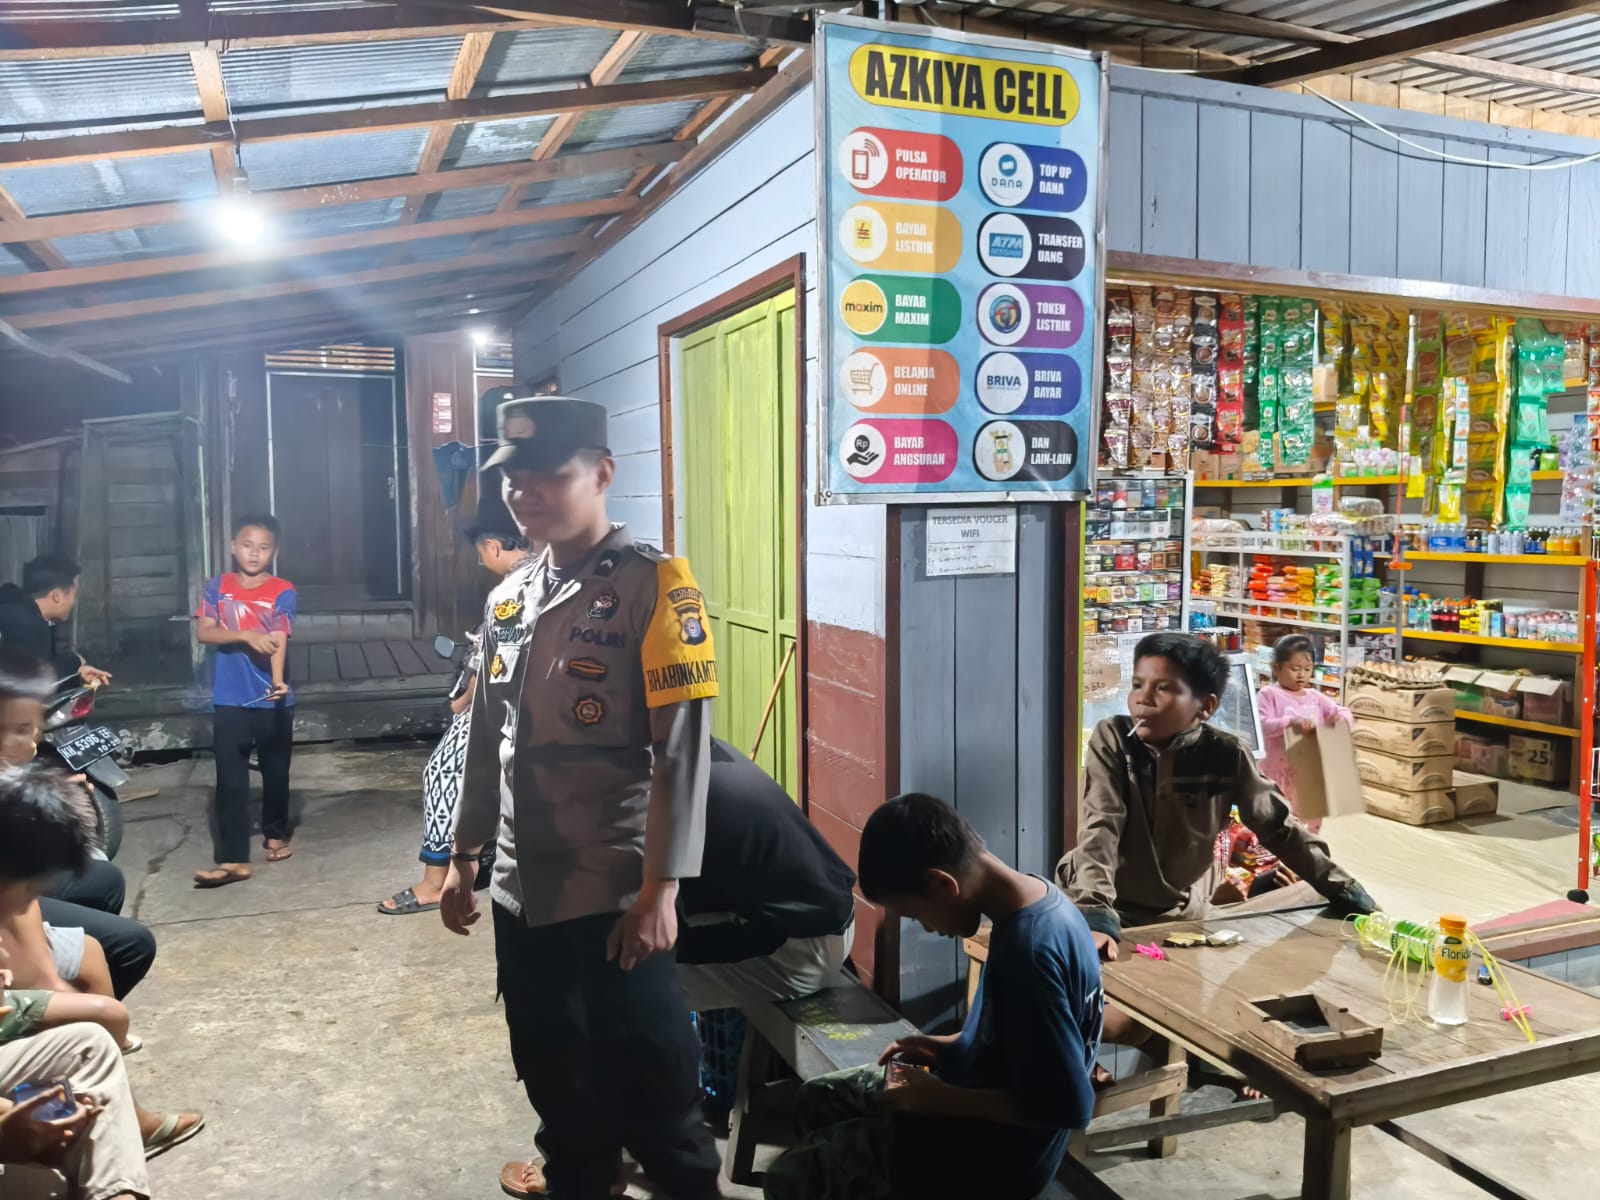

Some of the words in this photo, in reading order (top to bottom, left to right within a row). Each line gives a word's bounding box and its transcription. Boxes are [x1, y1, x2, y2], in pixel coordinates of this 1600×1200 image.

[865, 51, 986, 110] AZKIYA
[994, 67, 1066, 119] CELL
[896, 149, 927, 164] PULSA
[896, 166, 946, 183] OPERATOR
[1040, 164, 1057, 177] TOP
[1059, 166, 1072, 179] UP
[991, 177, 1023, 189] DANA
[1039, 180, 1064, 195] DANA
[896, 222, 926, 236] BAYAR
[896, 240, 933, 254] LISTRIK
[1038, 233, 1083, 248] TRANSFER
[1038, 250, 1063, 263] UANG
[845, 301, 883, 313] maxim
[895, 295, 926, 308] BAYAR
[1036, 302, 1066, 315] TOKEN
[895, 312, 930, 326] MAXIM
[1036, 319, 1071, 332] LISTRIK
[894, 366, 935, 380] BELANJA
[1034, 370, 1062, 383] BRIVA
[987, 375, 1021, 386] BRIVA
[894, 383, 928, 396] ONLINE
[1033, 386, 1062, 399] BAYAR
[855, 439, 868, 449] Rp
[894, 437, 924, 449] BAYAR
[1031, 437, 1050, 449] DAN
[893, 453, 945, 465] ANGSURAN
[1030, 451, 1072, 465] LAIN-LAIN
[932, 516, 972, 525] TERSEDIA
[973, 515, 1008, 524] VOUCER
[961, 529, 979, 538] WIFI
[75, 734, 100, 751] 5396
[1528, 749, 1548, 765] 25
